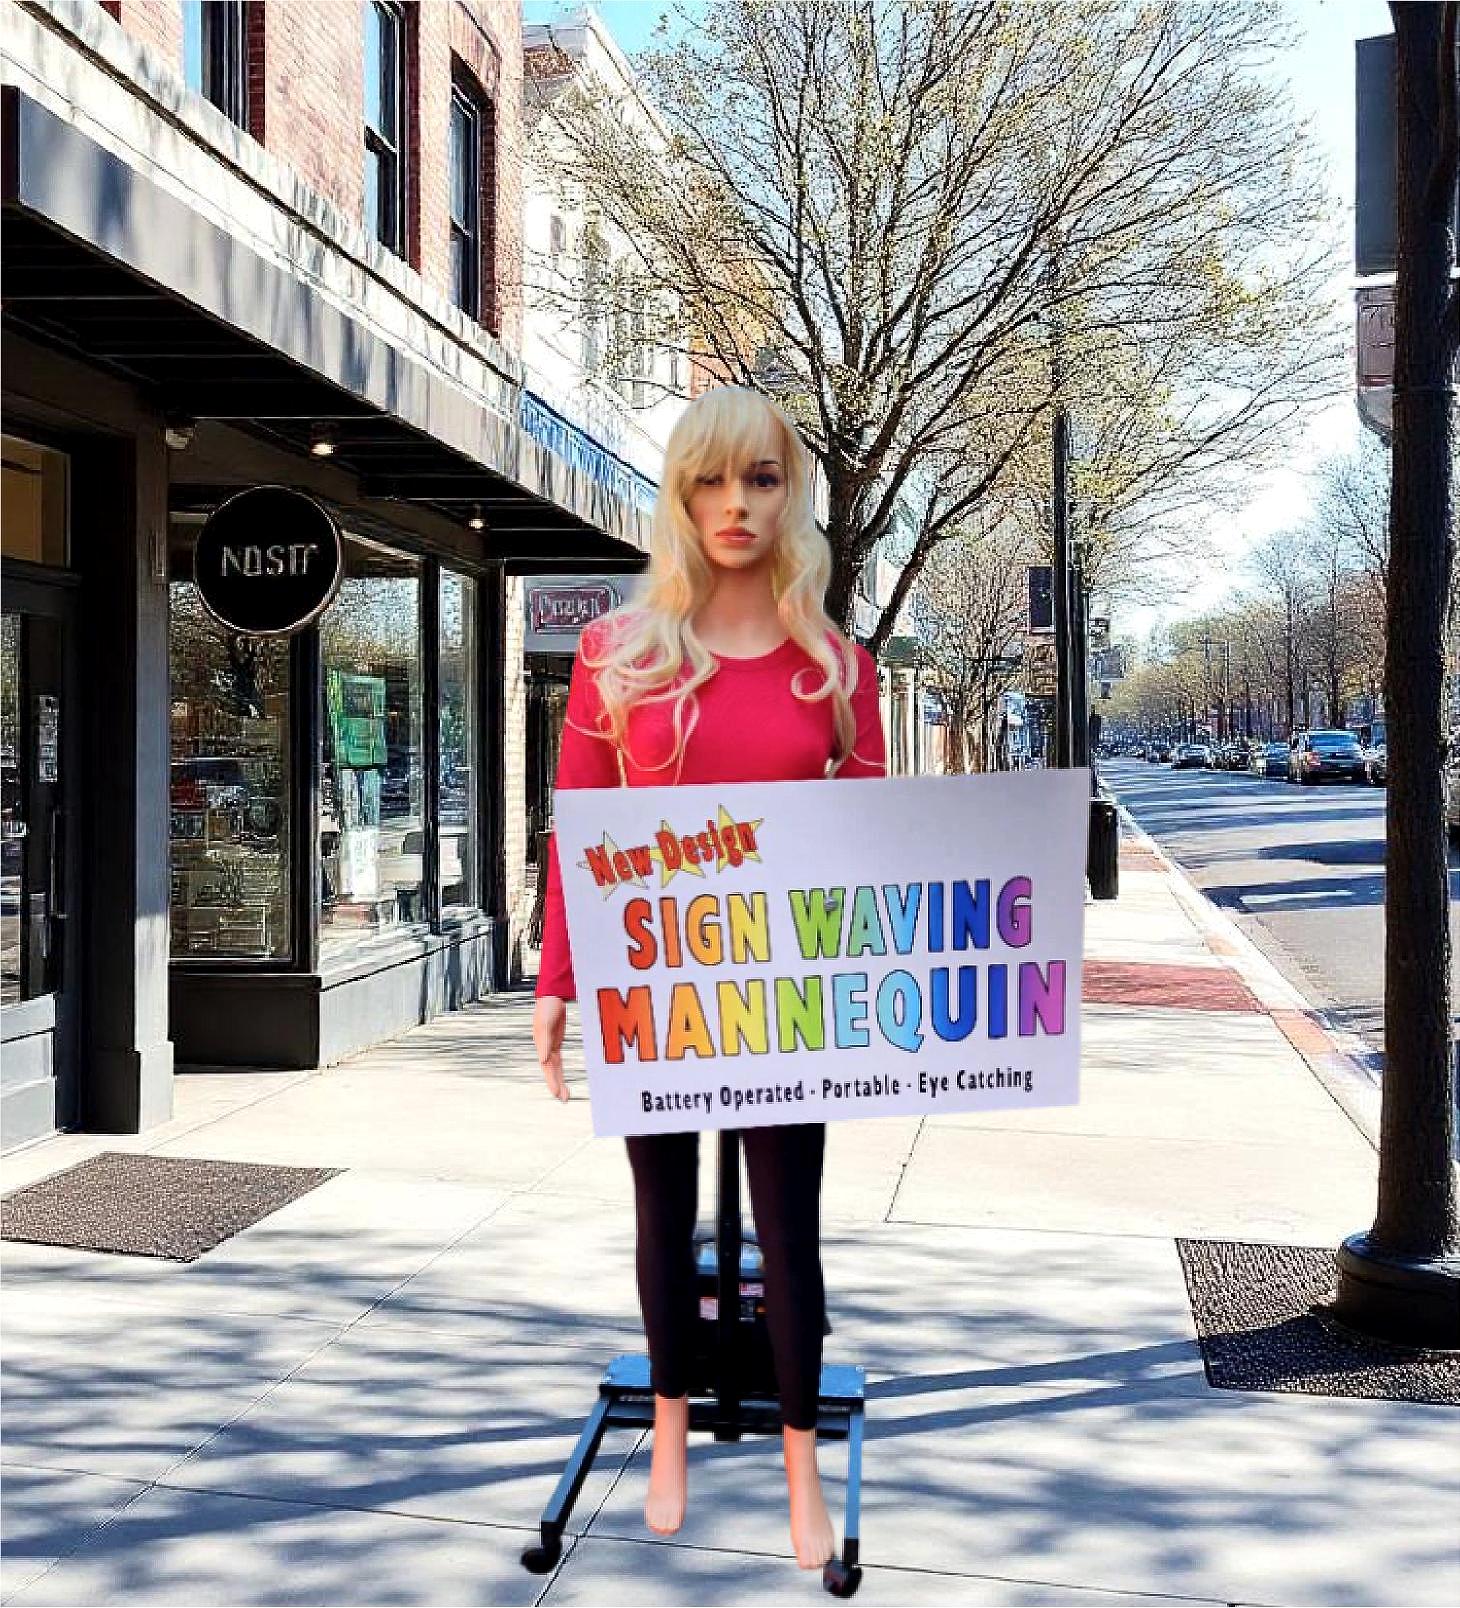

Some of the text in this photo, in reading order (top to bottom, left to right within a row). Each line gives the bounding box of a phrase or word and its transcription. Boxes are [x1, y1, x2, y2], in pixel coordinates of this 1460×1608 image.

[584, 819, 758, 886] New Design
[623, 875, 1033, 970] SIGN WAVING
[597, 959, 1067, 1064] MANNEQUIN
[641, 1089, 713, 1113] Battery
[719, 1081, 804, 1110] Operated
[822, 1074, 900, 1099] Portable
[918, 1072, 949, 1098] Eye
[956, 1066, 1034, 1092] Catching
